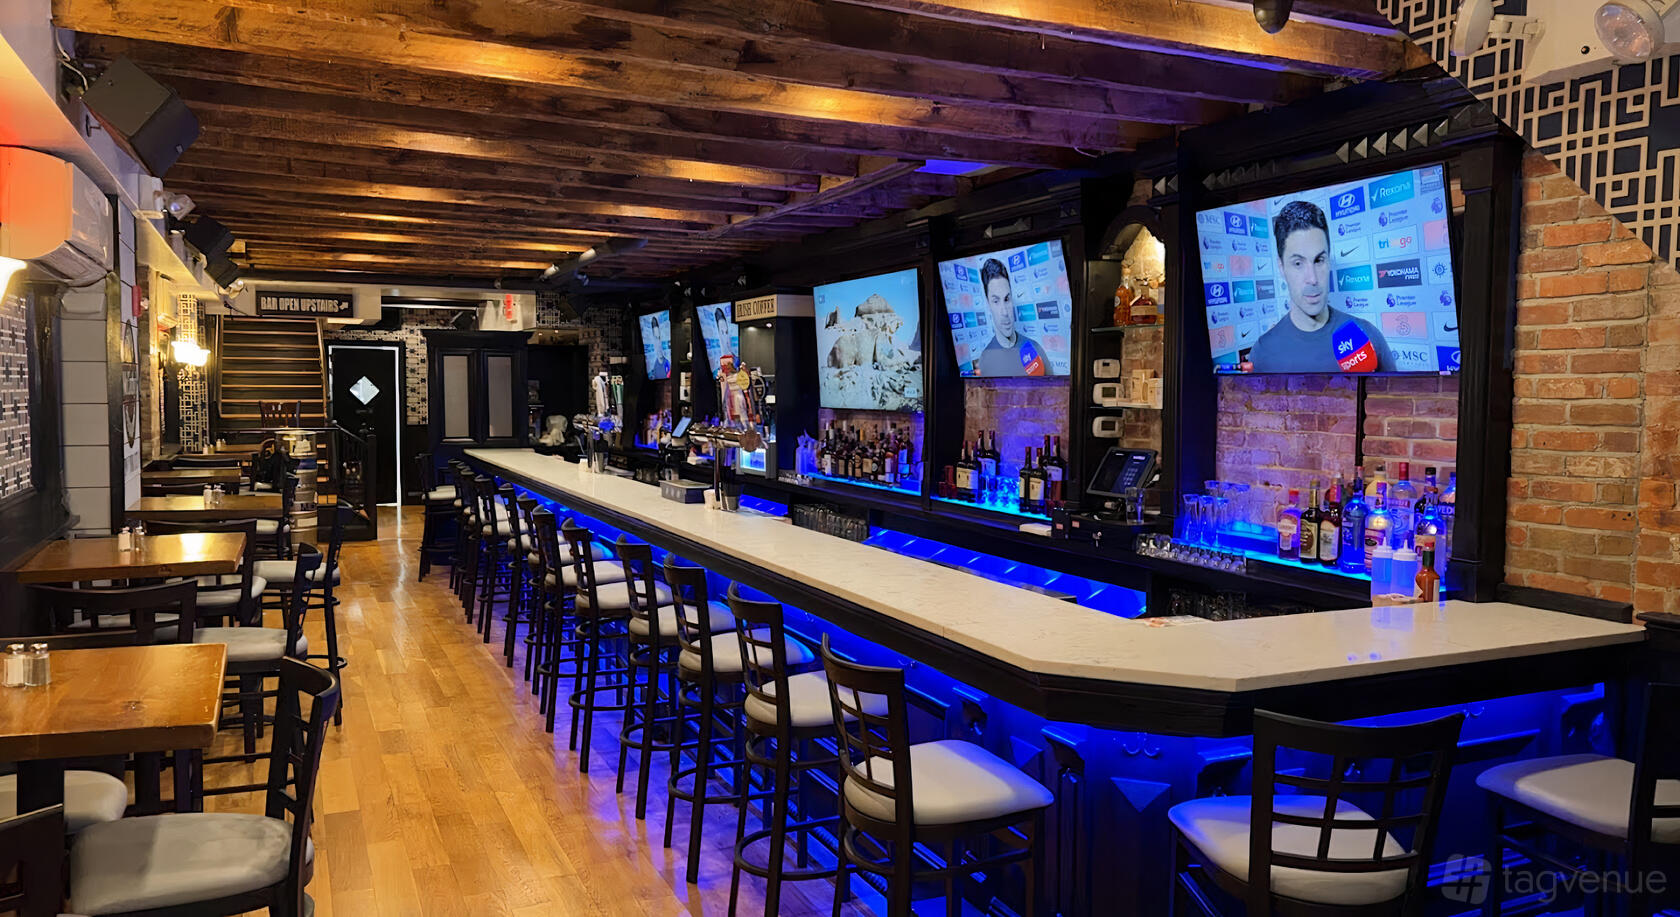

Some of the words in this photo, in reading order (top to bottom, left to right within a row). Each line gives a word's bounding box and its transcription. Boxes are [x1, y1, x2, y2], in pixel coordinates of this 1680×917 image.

[1379, 182, 1411, 198] Rexona
[1378, 236, 1412, 249] trigo
[260, 296, 278, 310] BAR
[279, 297, 299, 312] OPEN
[300, 298, 339, 313] UPSTAIRS
[736, 303, 752, 318] IRISH
[753, 298, 775, 315] COFFEE
[1338, 339, 1353, 354] sky
[1341, 351, 1368, 371] sports
[1401, 350, 1428, 362] MSC
